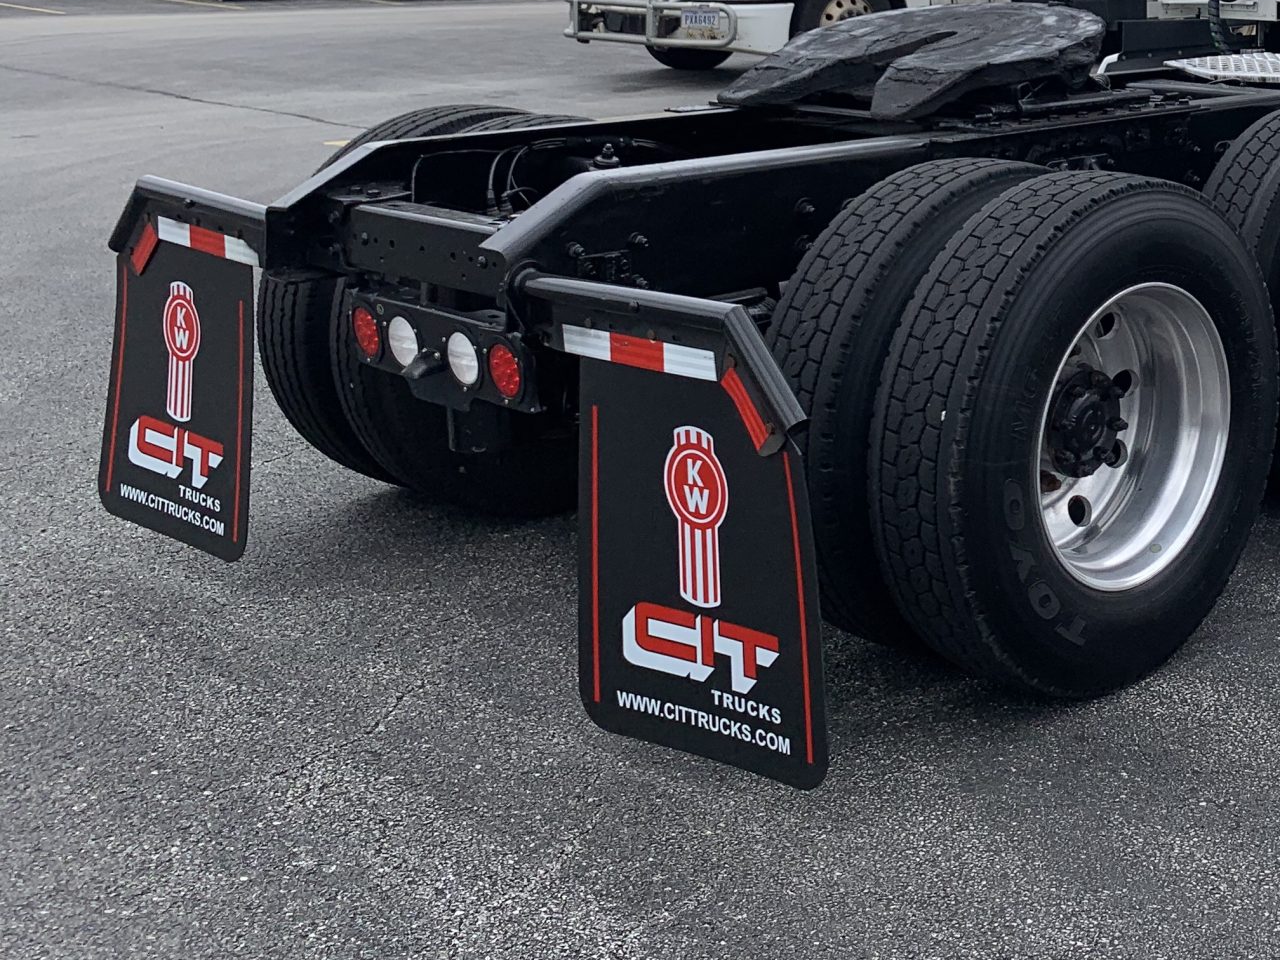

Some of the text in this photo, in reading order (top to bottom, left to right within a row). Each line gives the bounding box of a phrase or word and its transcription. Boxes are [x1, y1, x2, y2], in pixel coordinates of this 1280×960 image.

[128, 415, 224, 489] CIT
[120, 484, 225, 537] WWW.CITTRUCKS.COM
[178, 484, 221, 512] TRUCKS
[1003, 477, 1088, 648] TOYO
[622, 601, 780, 695] CIT
[616, 690, 791, 756] WWW.CITTRUCKS.COM
[711, 689, 782, 725] TRUCKS
